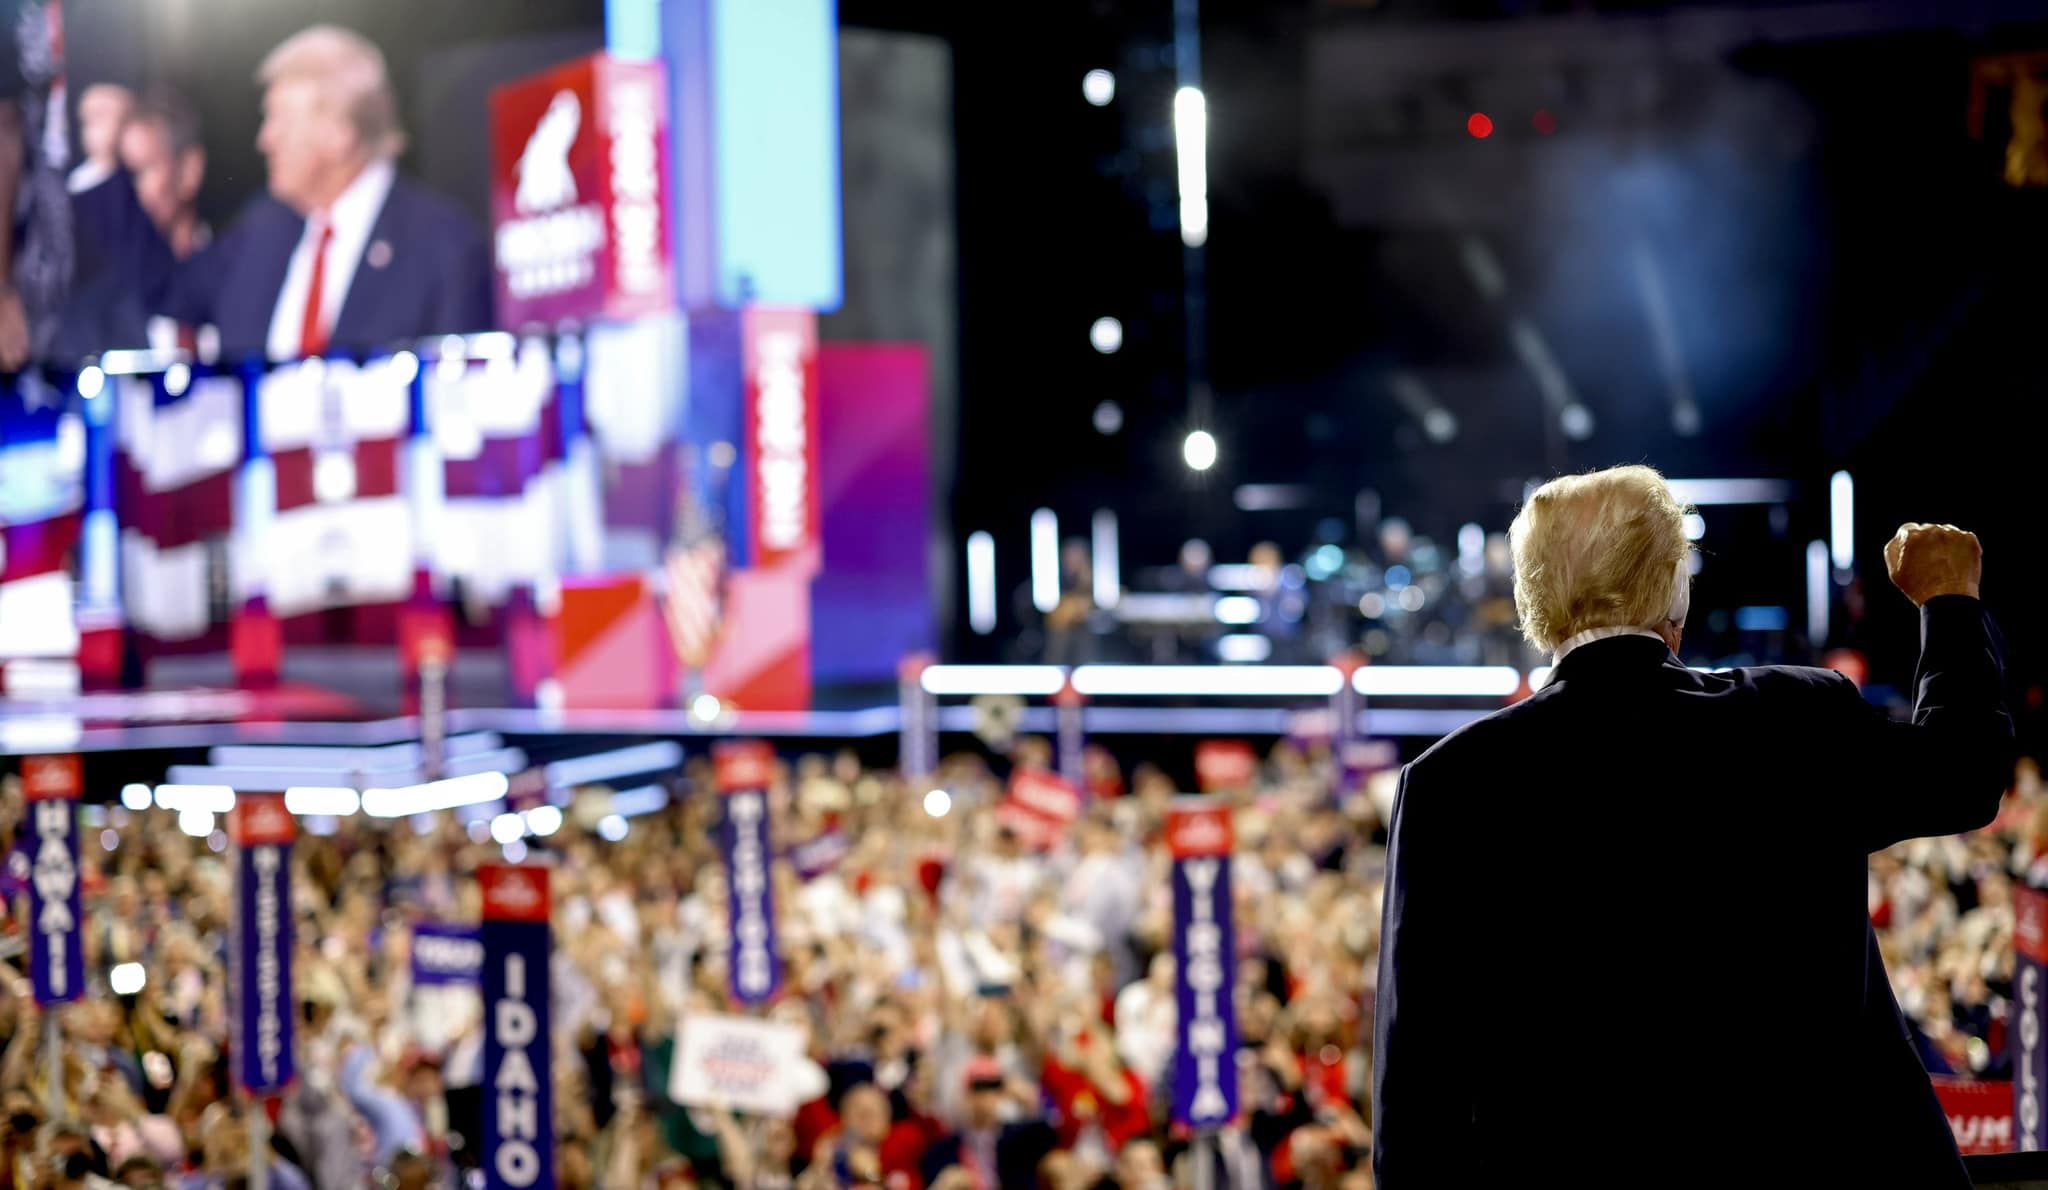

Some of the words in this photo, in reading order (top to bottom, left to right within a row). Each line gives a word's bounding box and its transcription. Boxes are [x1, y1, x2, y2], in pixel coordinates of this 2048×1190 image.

[33, 799, 76, 996] HAWAII
[1183, 858, 1230, 1120] VIRGINIA
[494, 953, 540, 1188] IDAHO
